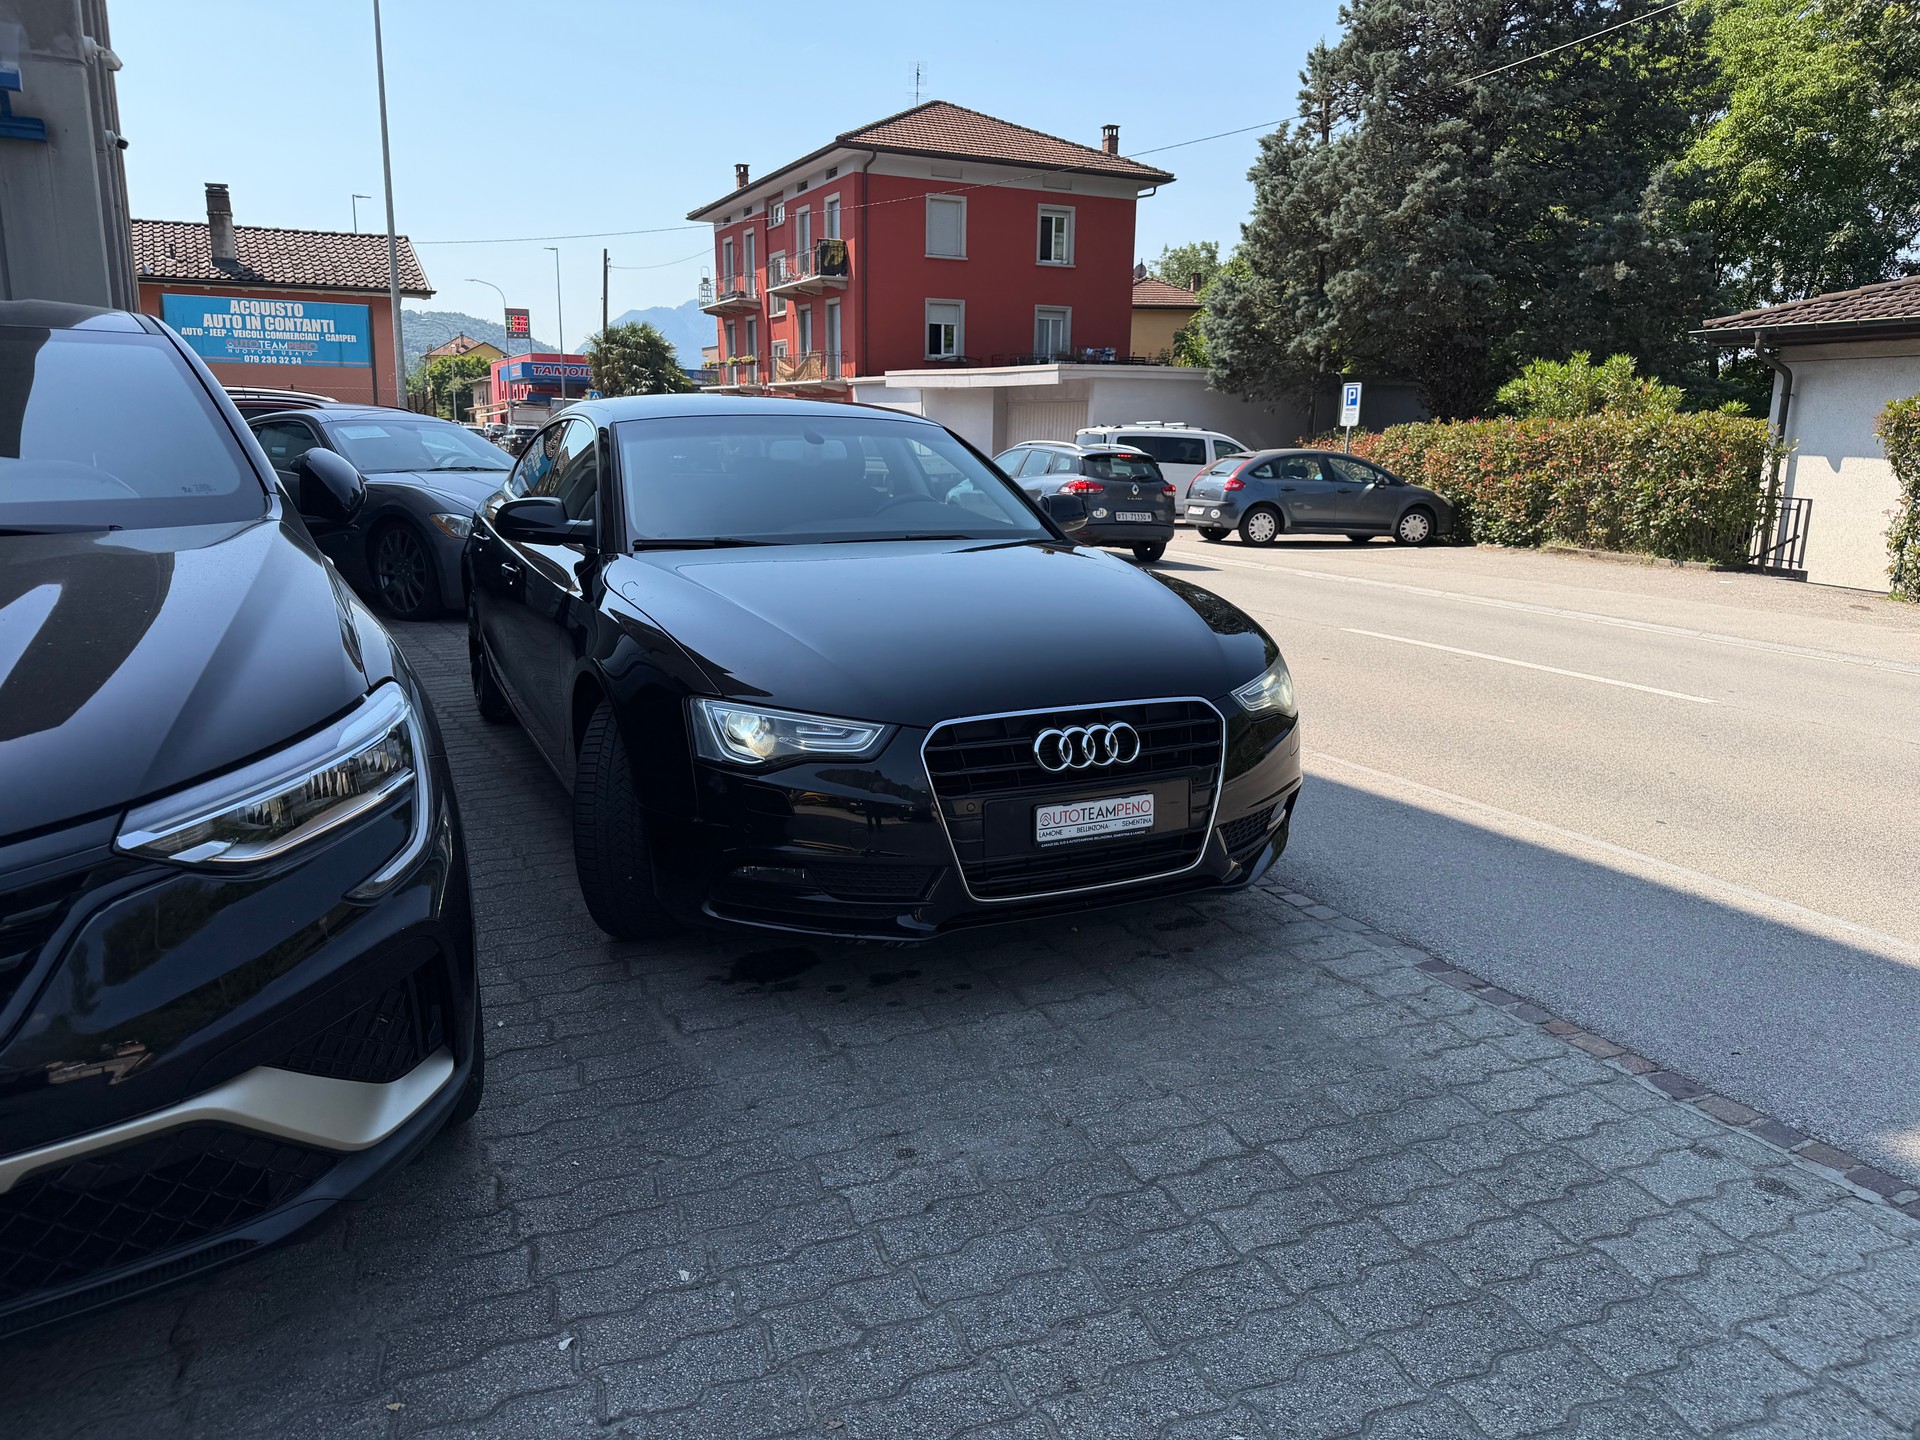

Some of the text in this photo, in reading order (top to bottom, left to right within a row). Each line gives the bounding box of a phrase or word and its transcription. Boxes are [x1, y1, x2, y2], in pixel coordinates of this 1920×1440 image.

[230, 300, 304, 317] ACQUISTO
[203, 313, 335, 333] AUTO IN CONTANTI
[181, 327, 203, 336] AUTO
[209, 328, 227, 337] JEEP
[232, 329, 264, 339] VEICOLI
[265, 331, 320, 341] COMMERCIALI
[325, 333, 357, 343] CAMPER
[244, 355, 302, 365] 079 230 32 34
[532, 365, 593, 377] TAMOIL
[1347, 388, 1357, 405] P
[1038, 817, 1152, 838] LAMONE BELLINZONA SEMENTINA
